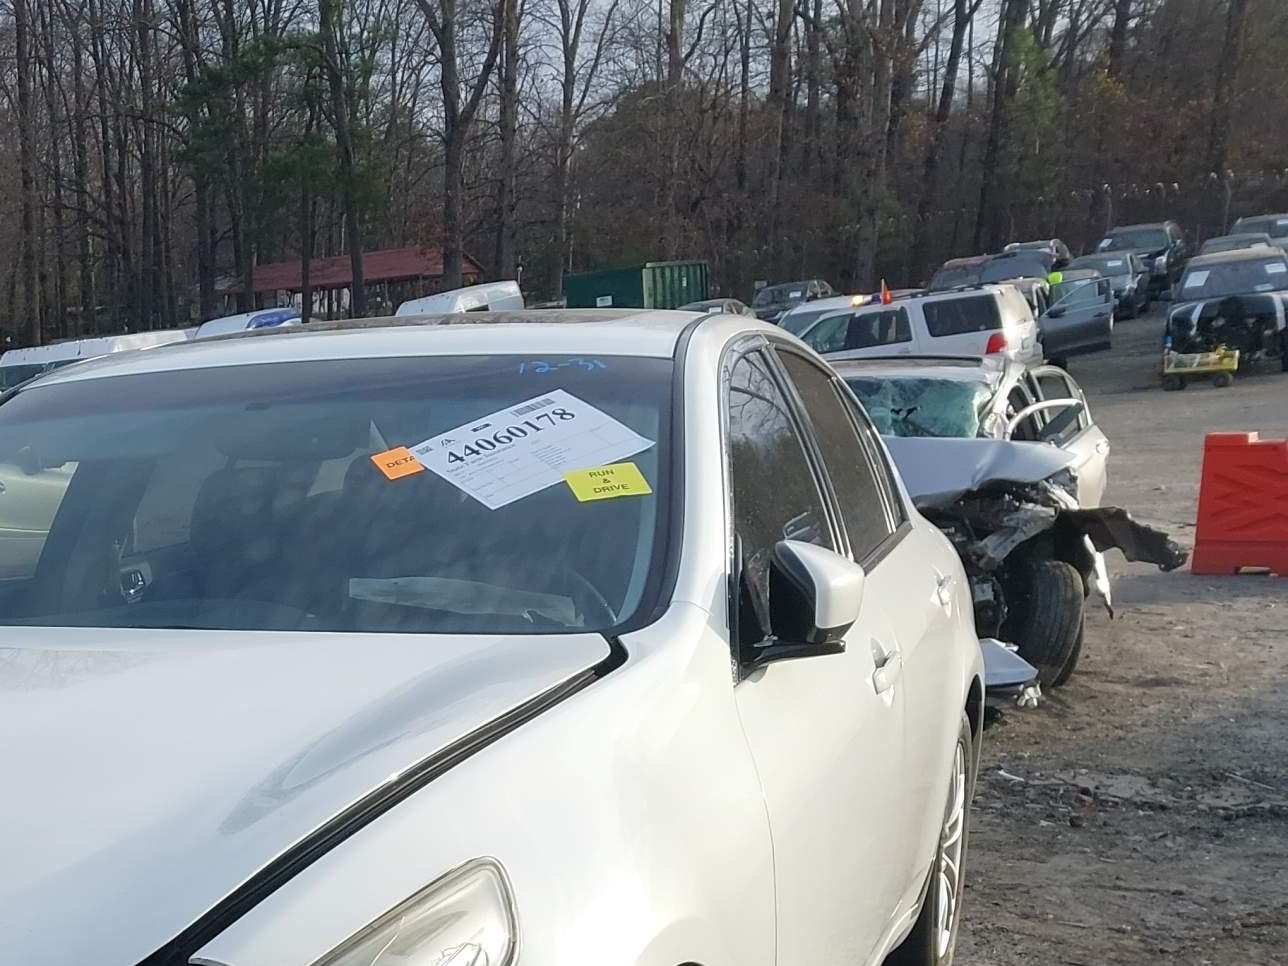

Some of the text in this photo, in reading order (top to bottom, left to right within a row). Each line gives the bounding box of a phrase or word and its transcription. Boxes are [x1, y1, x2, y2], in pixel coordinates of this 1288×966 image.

[448, 408, 575, 464] 44060178
[588, 469, 615, 478] RUN
[592, 483, 631, 494] DRIVE
